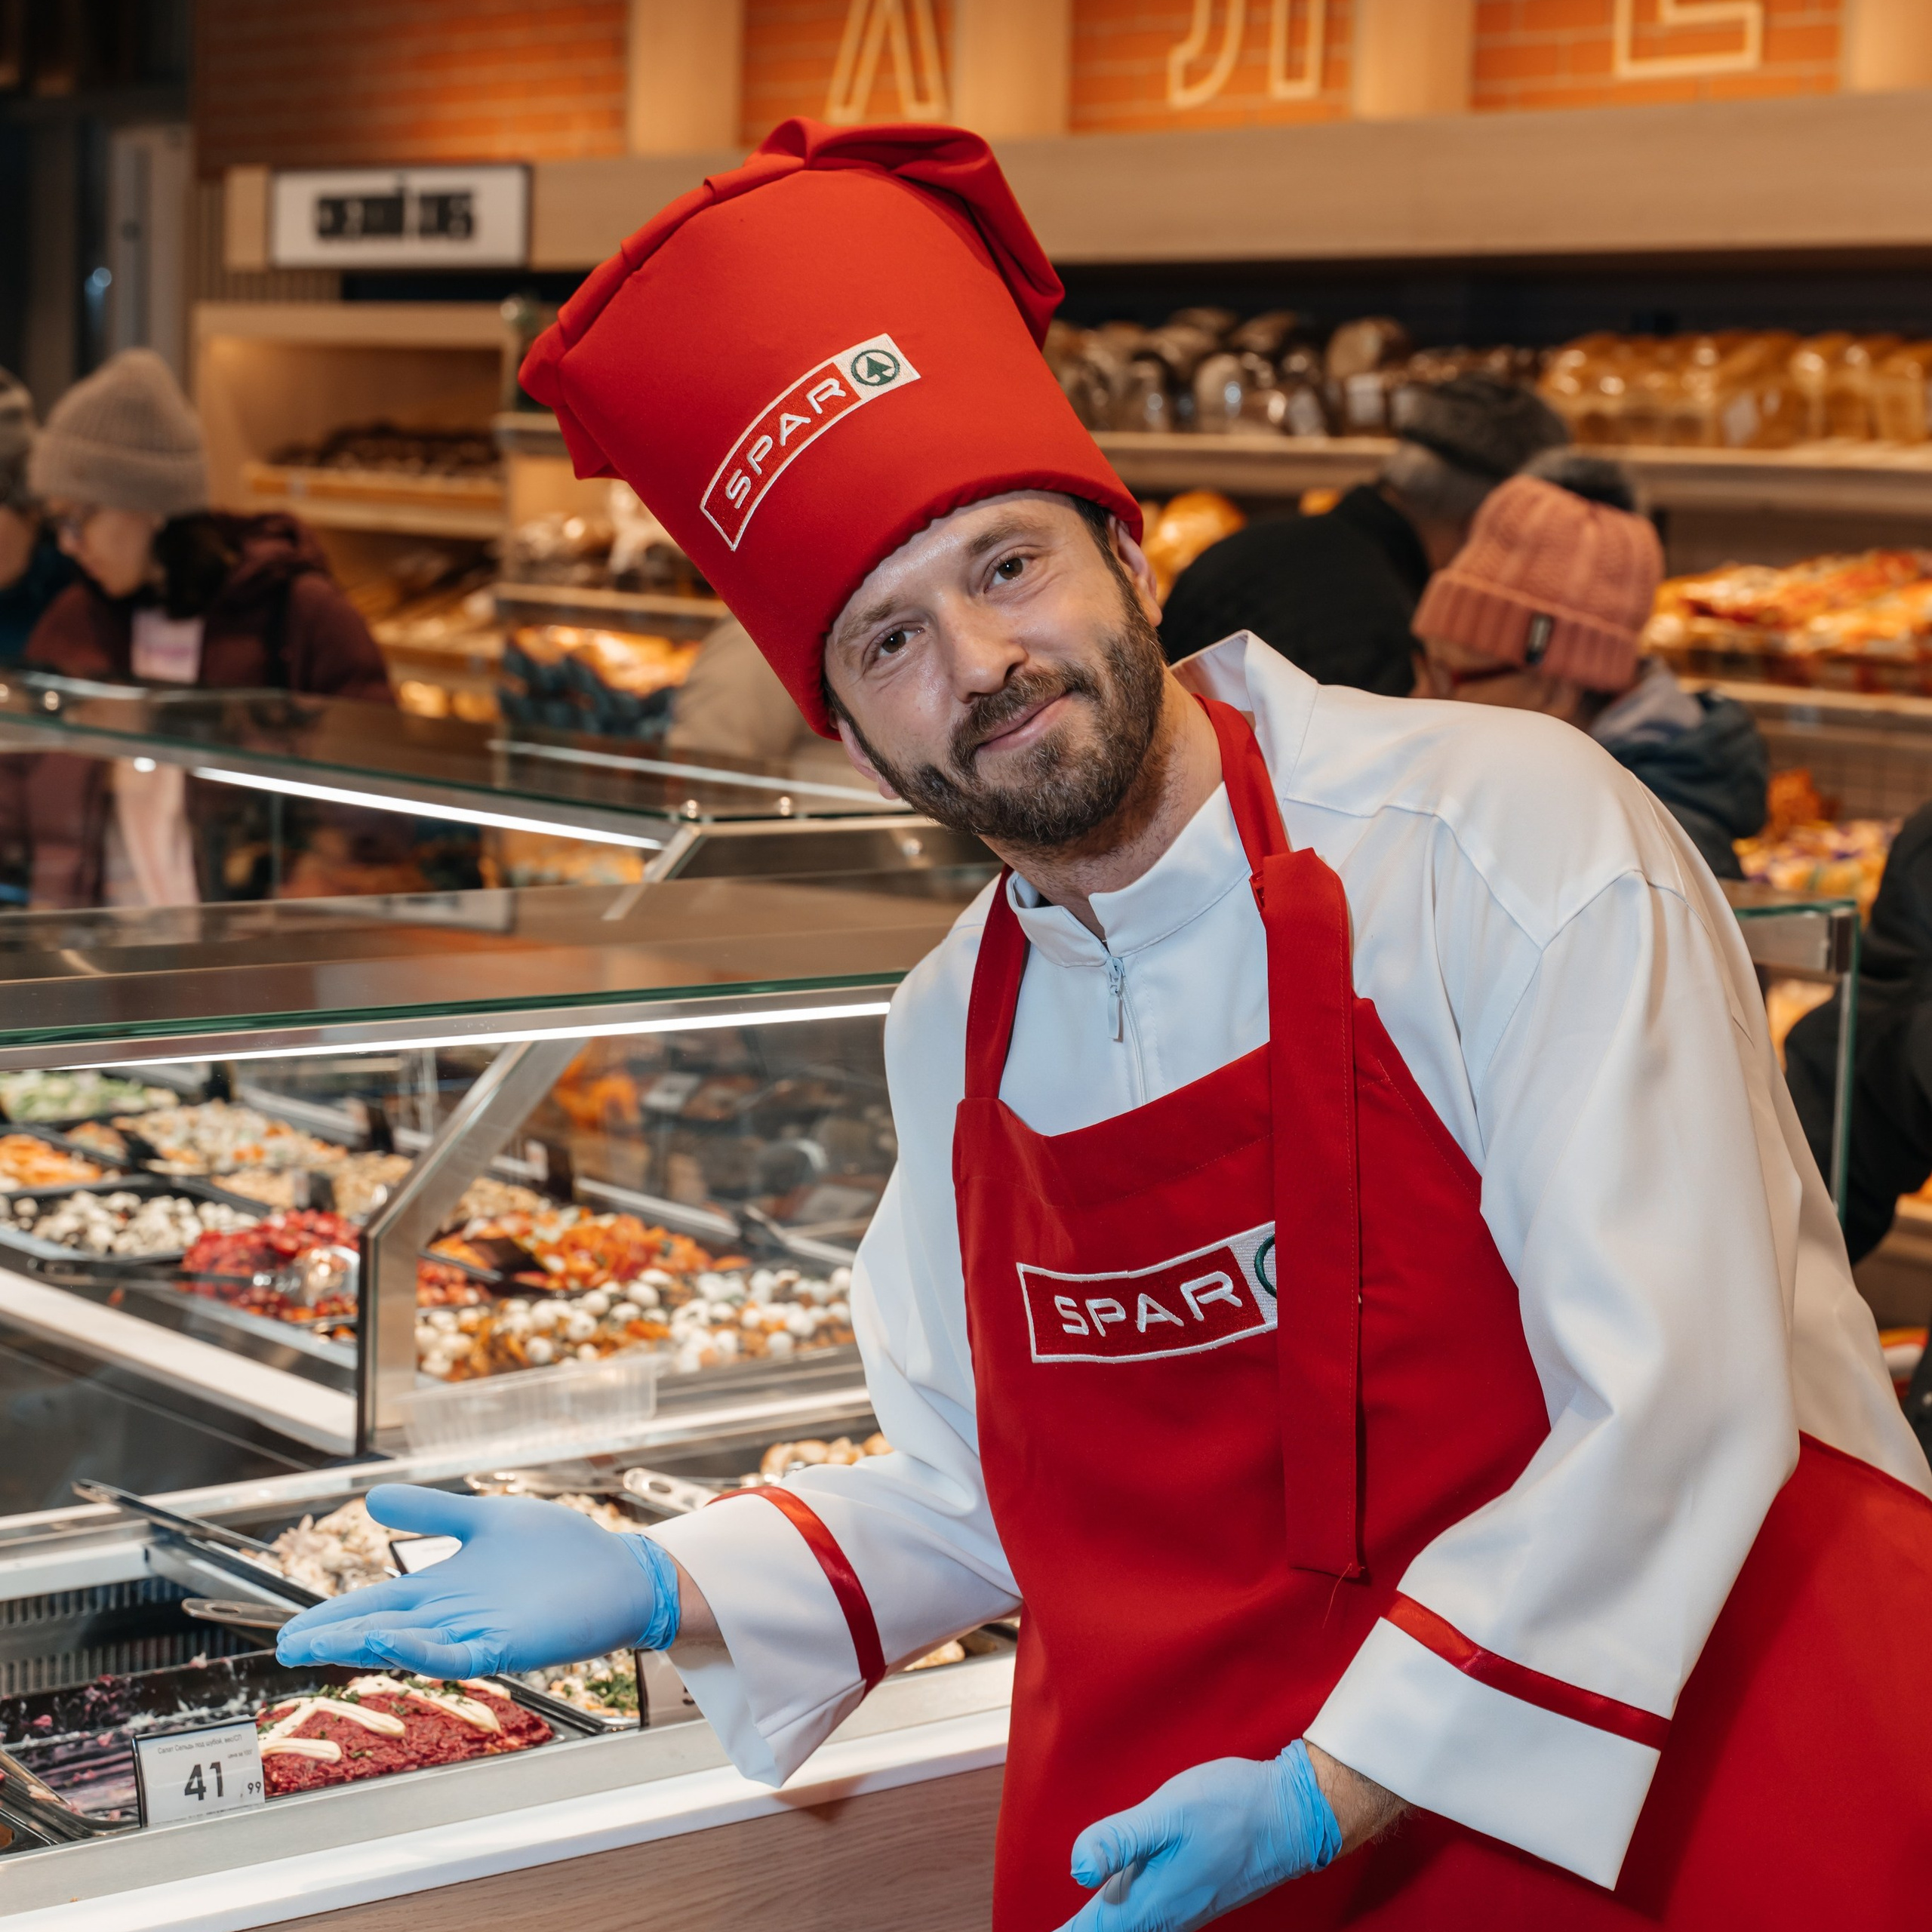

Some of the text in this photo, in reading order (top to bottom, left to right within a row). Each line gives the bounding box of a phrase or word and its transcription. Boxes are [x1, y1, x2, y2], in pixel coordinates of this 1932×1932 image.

[725, 377, 847, 509] SPAR
[1054, 1270, 1243, 1337] SPAR
[157, 1746, 174, 1755] Салат
[174, 1743, 195, 1752] Сельдь
[184, 1761, 224, 1801] 41
